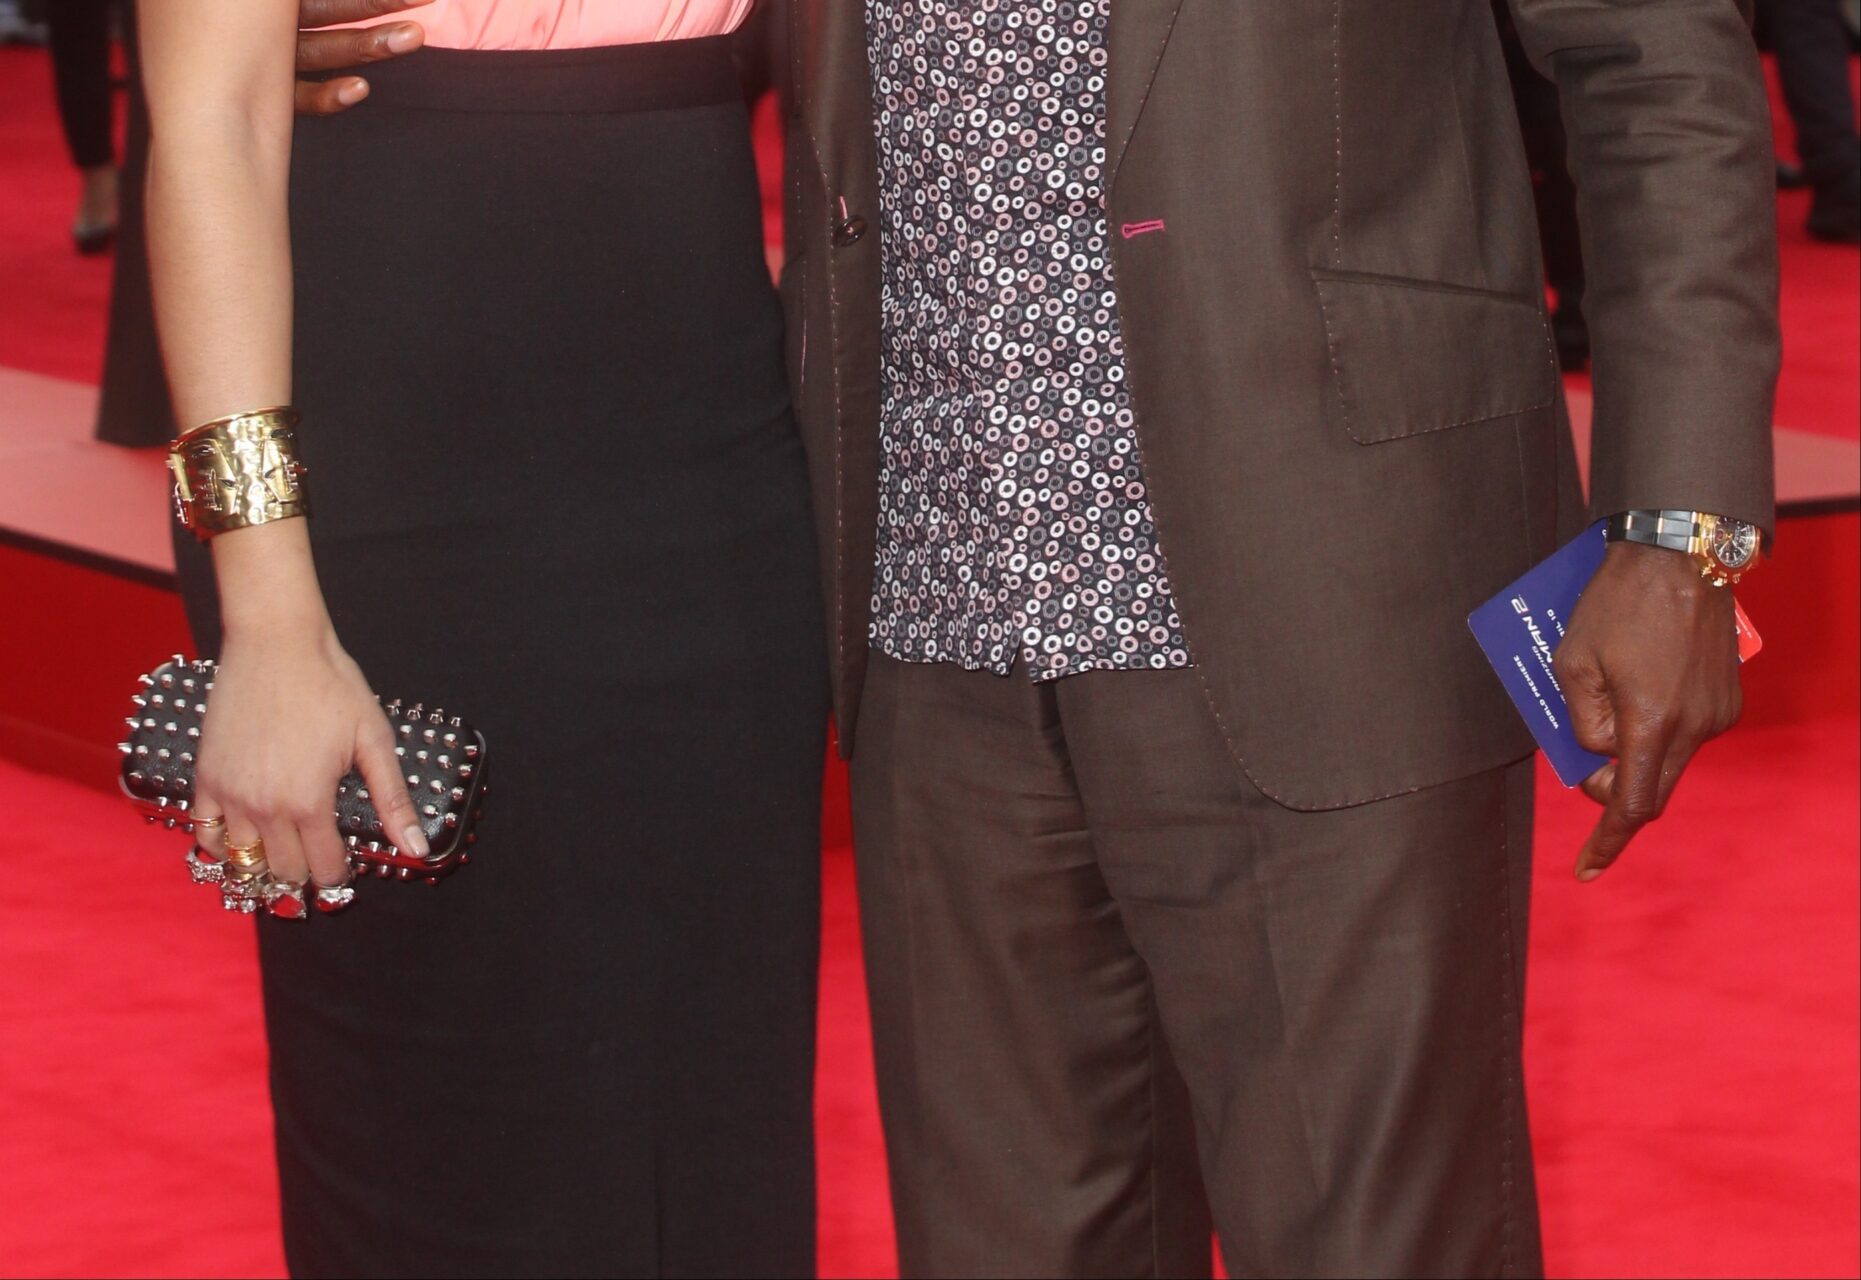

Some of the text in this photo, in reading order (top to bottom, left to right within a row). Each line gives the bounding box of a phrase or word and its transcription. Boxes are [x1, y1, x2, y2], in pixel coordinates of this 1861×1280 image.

[1511, 598, 1529, 614] 2
[1532, 645, 1560, 691] AMAZING
[1513, 655, 1559, 729] WORLD PREMIERE
